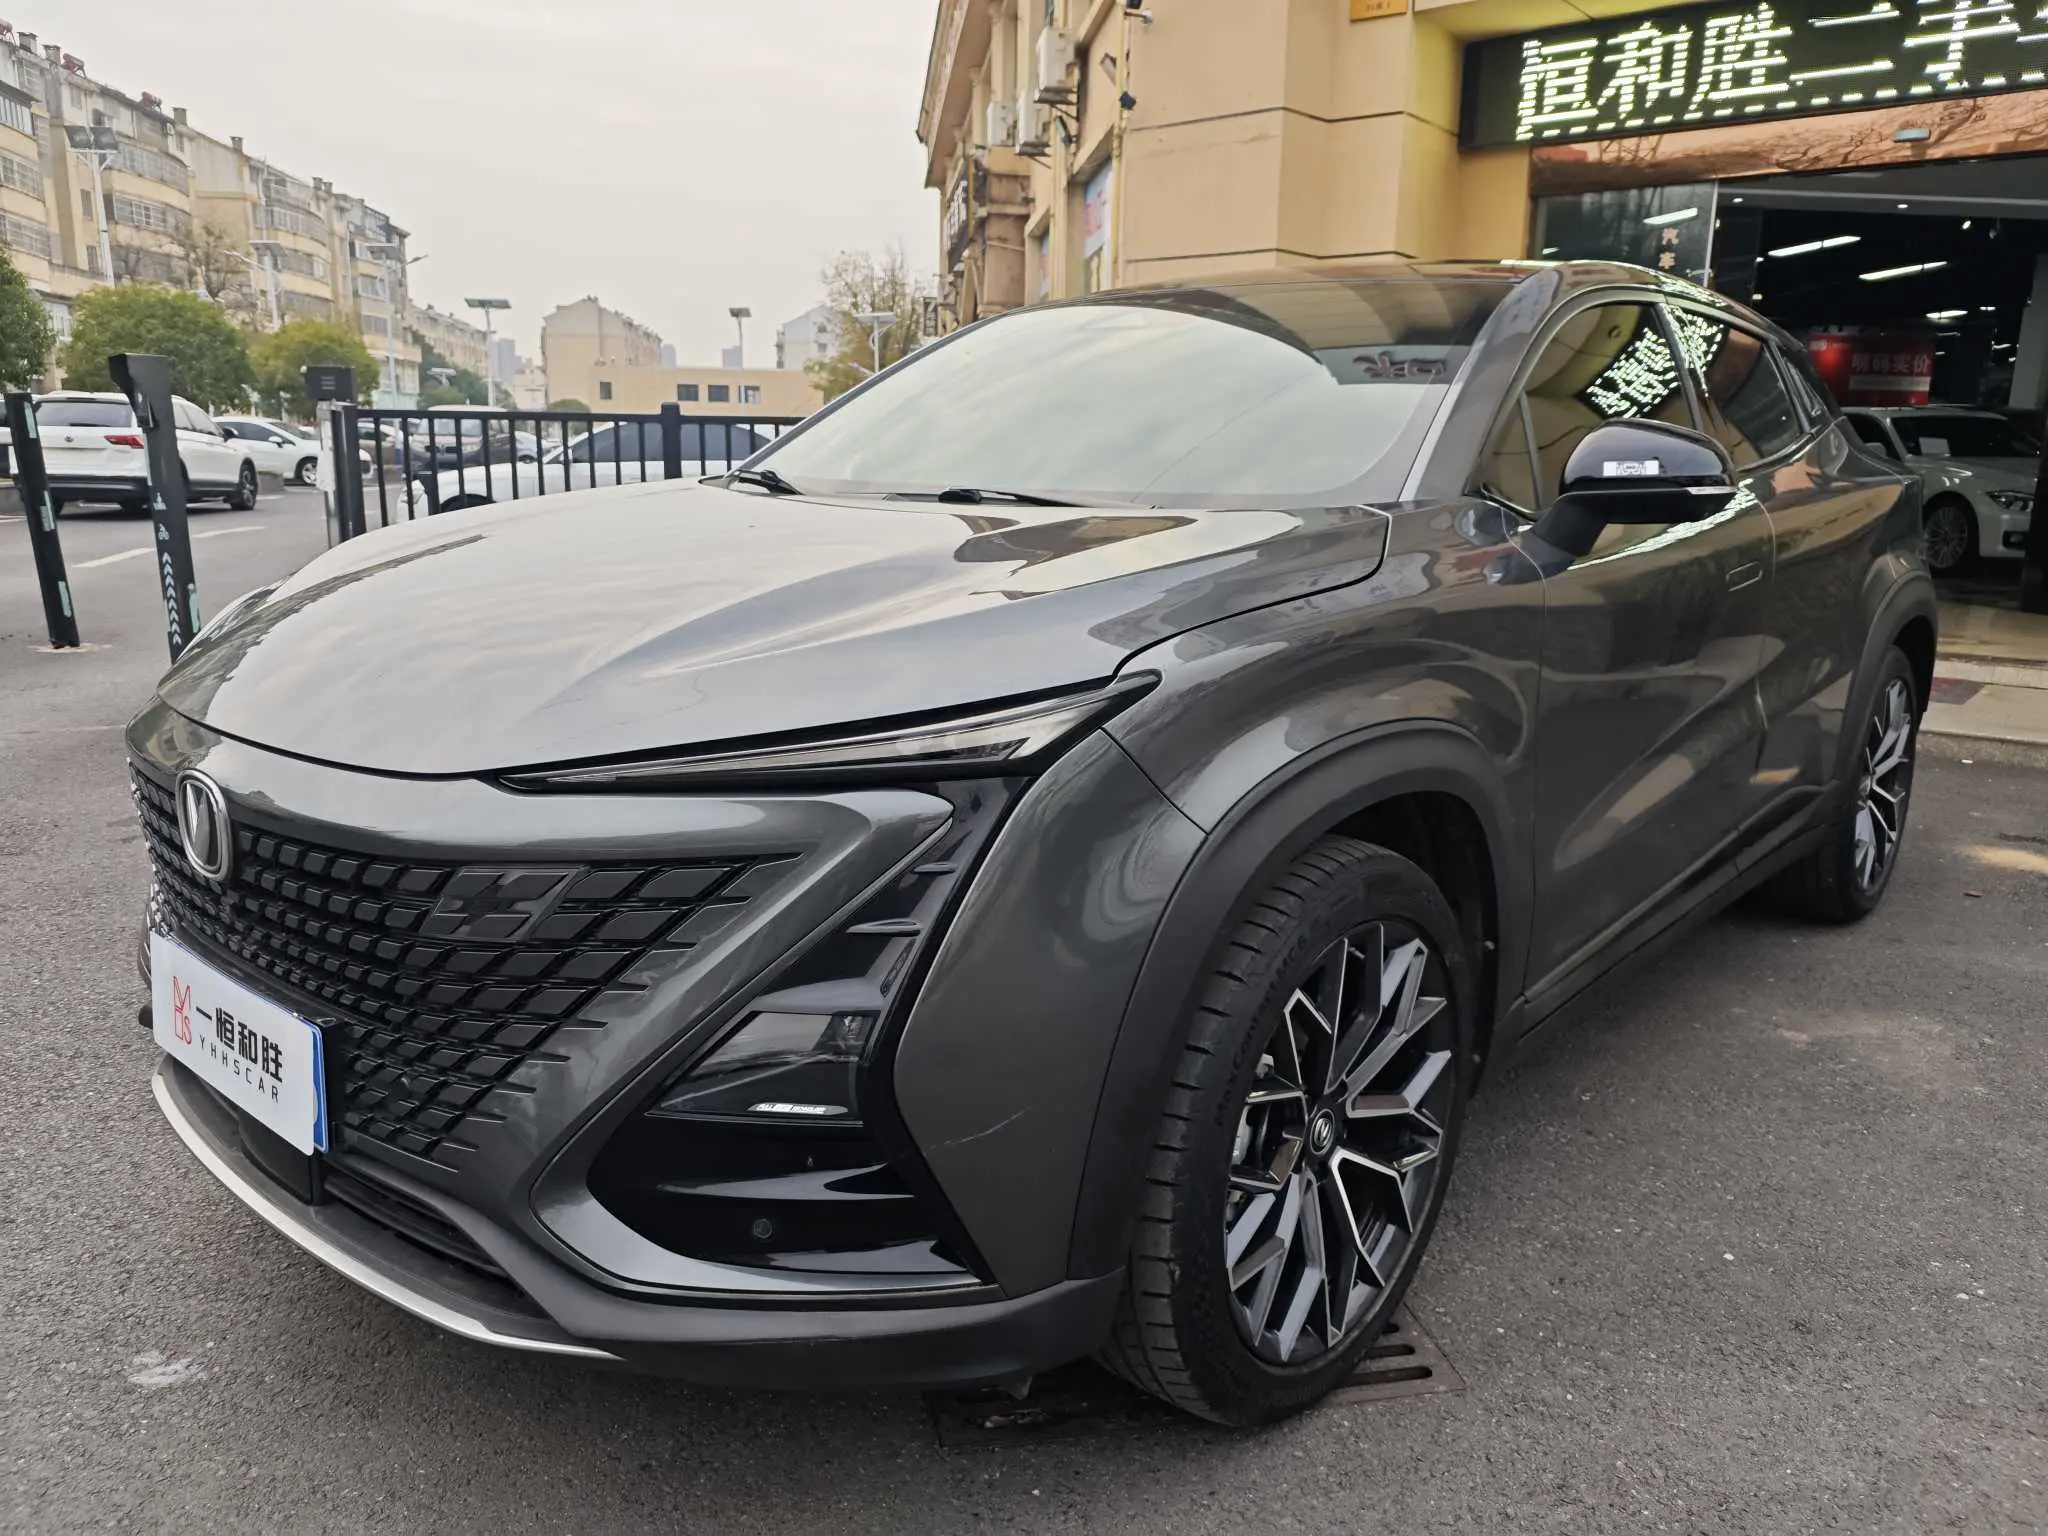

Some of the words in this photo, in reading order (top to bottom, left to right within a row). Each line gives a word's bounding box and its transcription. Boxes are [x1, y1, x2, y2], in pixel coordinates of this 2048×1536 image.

[1516, 0, 2048, 134] 恒和胜二手
[196, 1006, 283, 1083] 一恒和胜
[199, 1033, 280, 1103] YHHSCAR
